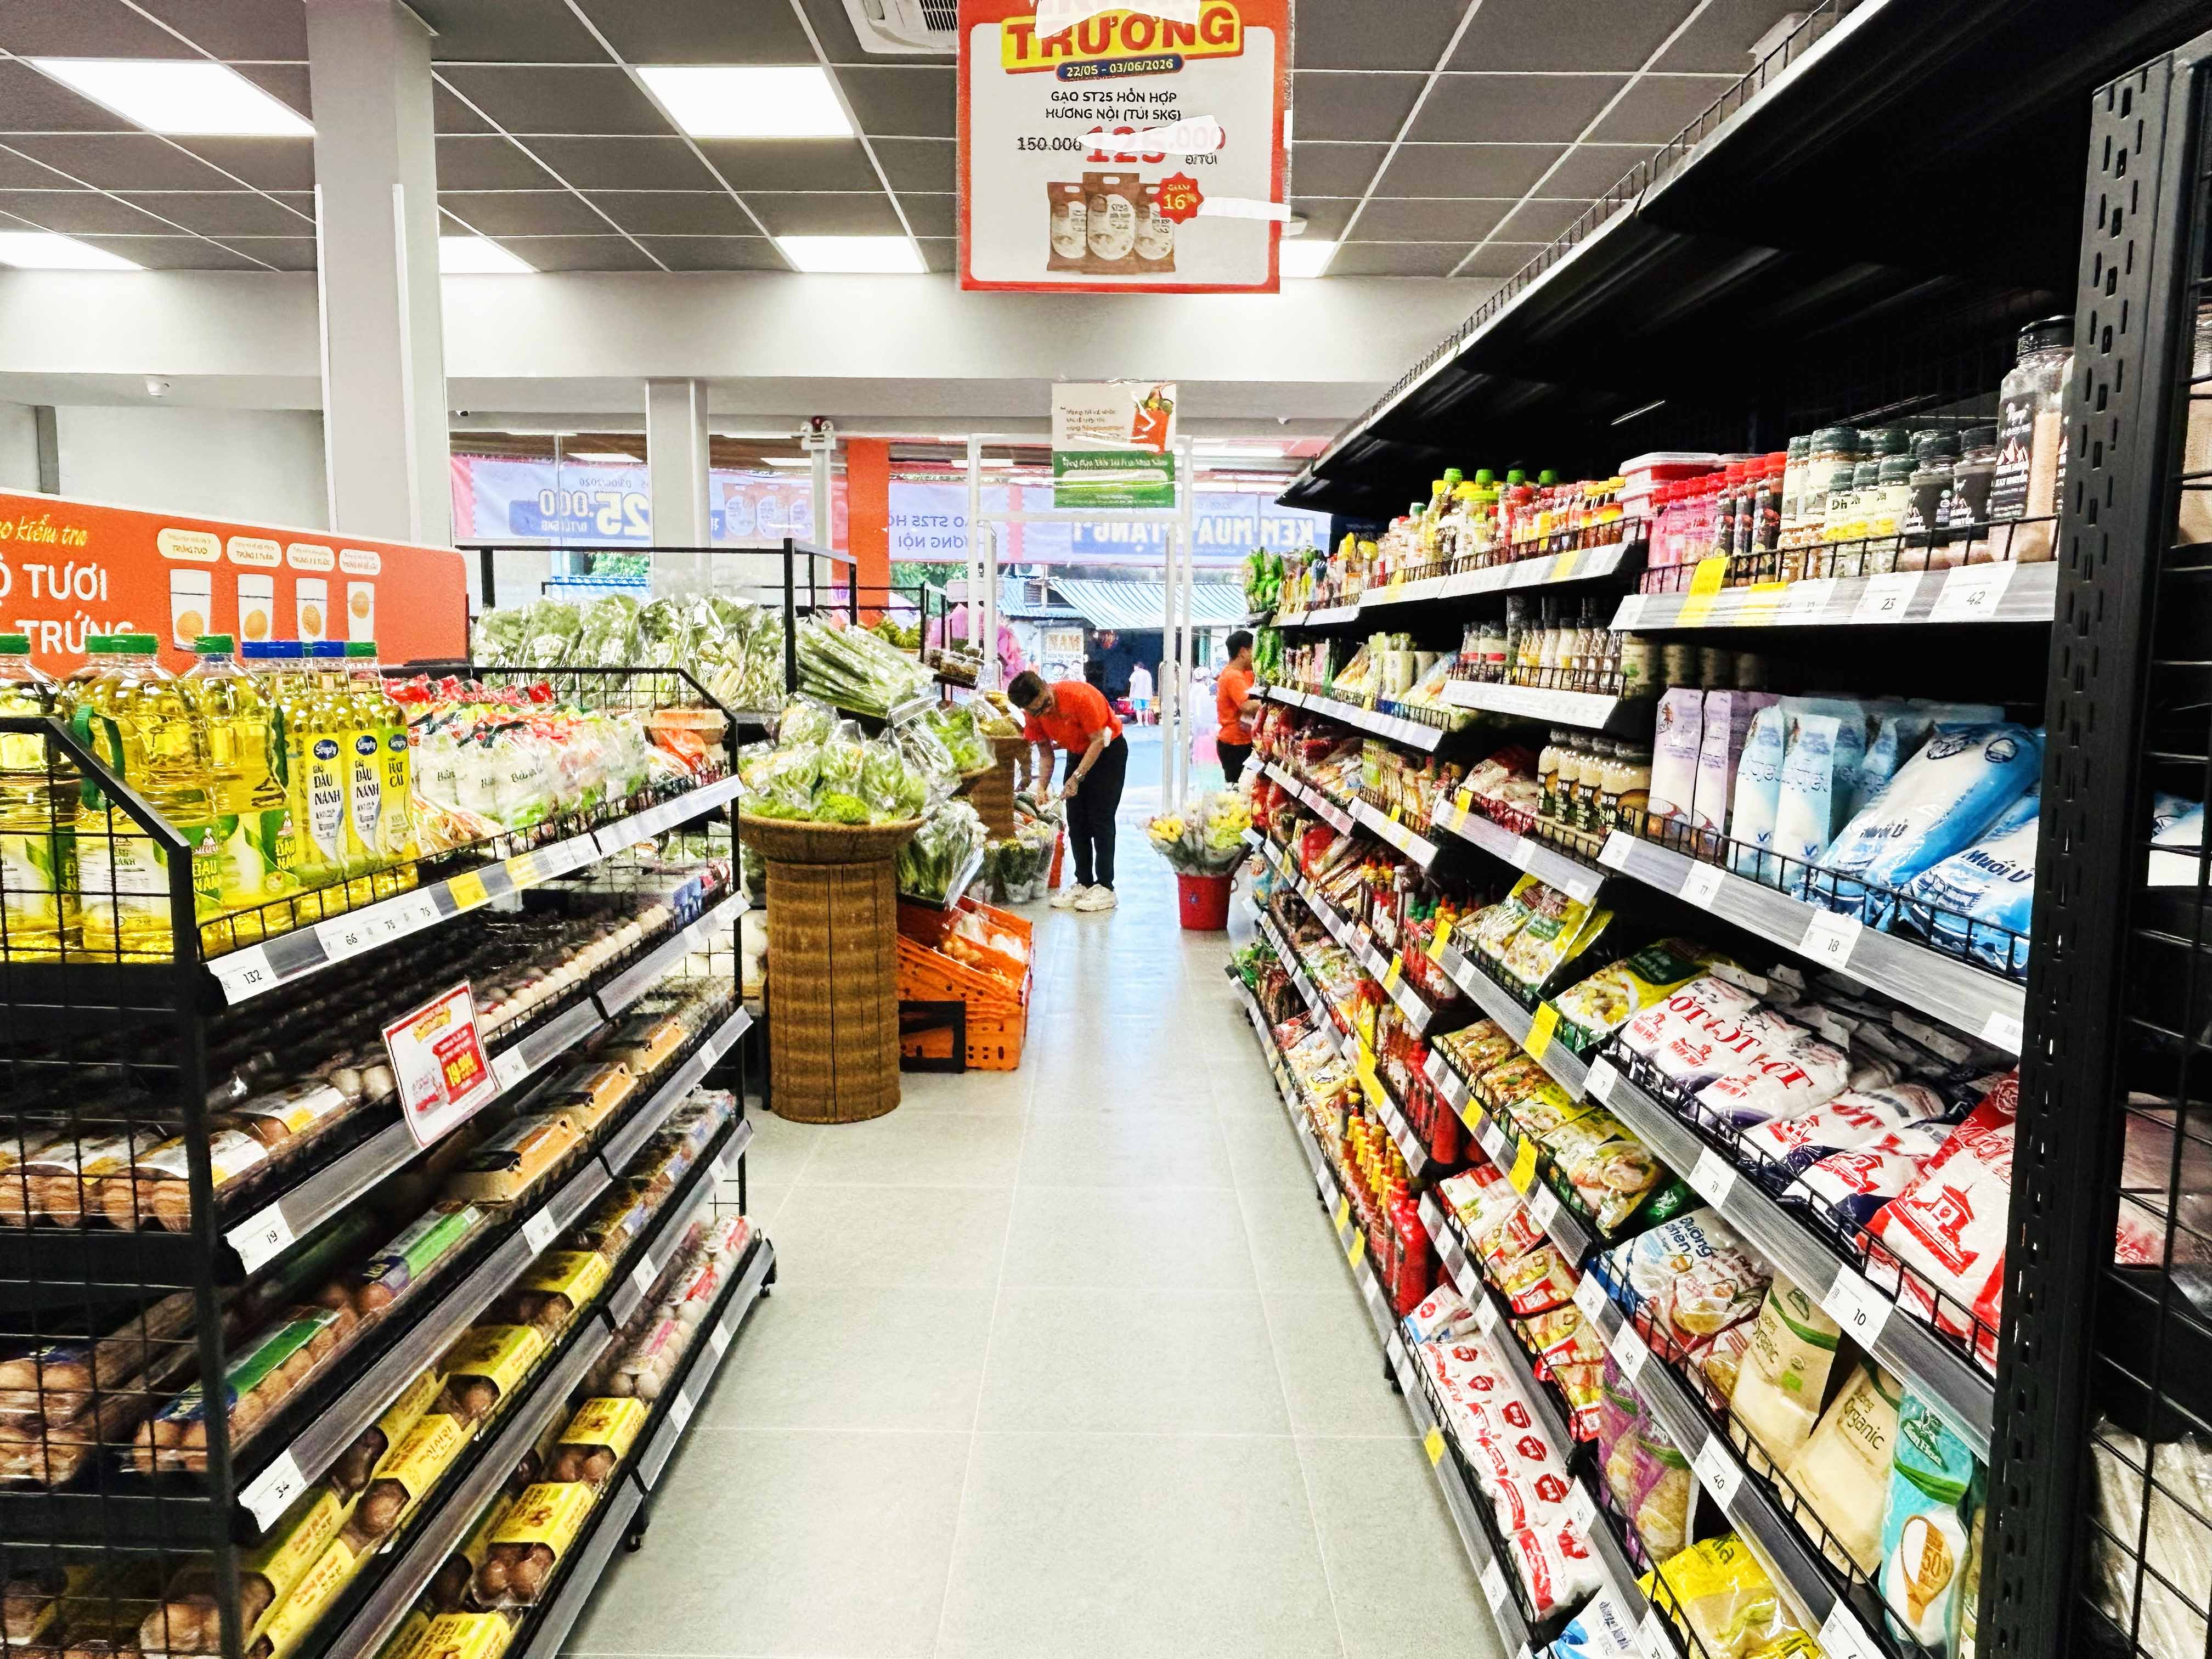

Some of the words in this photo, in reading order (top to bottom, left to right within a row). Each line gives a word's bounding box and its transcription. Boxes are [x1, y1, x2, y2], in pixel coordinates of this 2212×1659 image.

[1109, 59, 1174, 74] 03/06/2026
[1051, 92, 1079, 104] GẠO
[1082, 92, 1113, 103] ST25
[1149, 92, 1177, 105] HỢP
[1046, 107, 1093, 120] HƯƠNG
[1096, 105, 1119, 121] NỘI
[1124, 107, 1148, 122] (TÚI
[1153, 108, 1182, 122] 5KG)
[22, 561, 107, 601] TƯƠI
[1881, 597, 1897, 611] 23
[243, 969, 263, 984] 132
[1853, 1308, 1866, 1326] 10
[1843, 1398, 1885, 1450] Organic
[1713, 1474, 1725, 1490] 40
